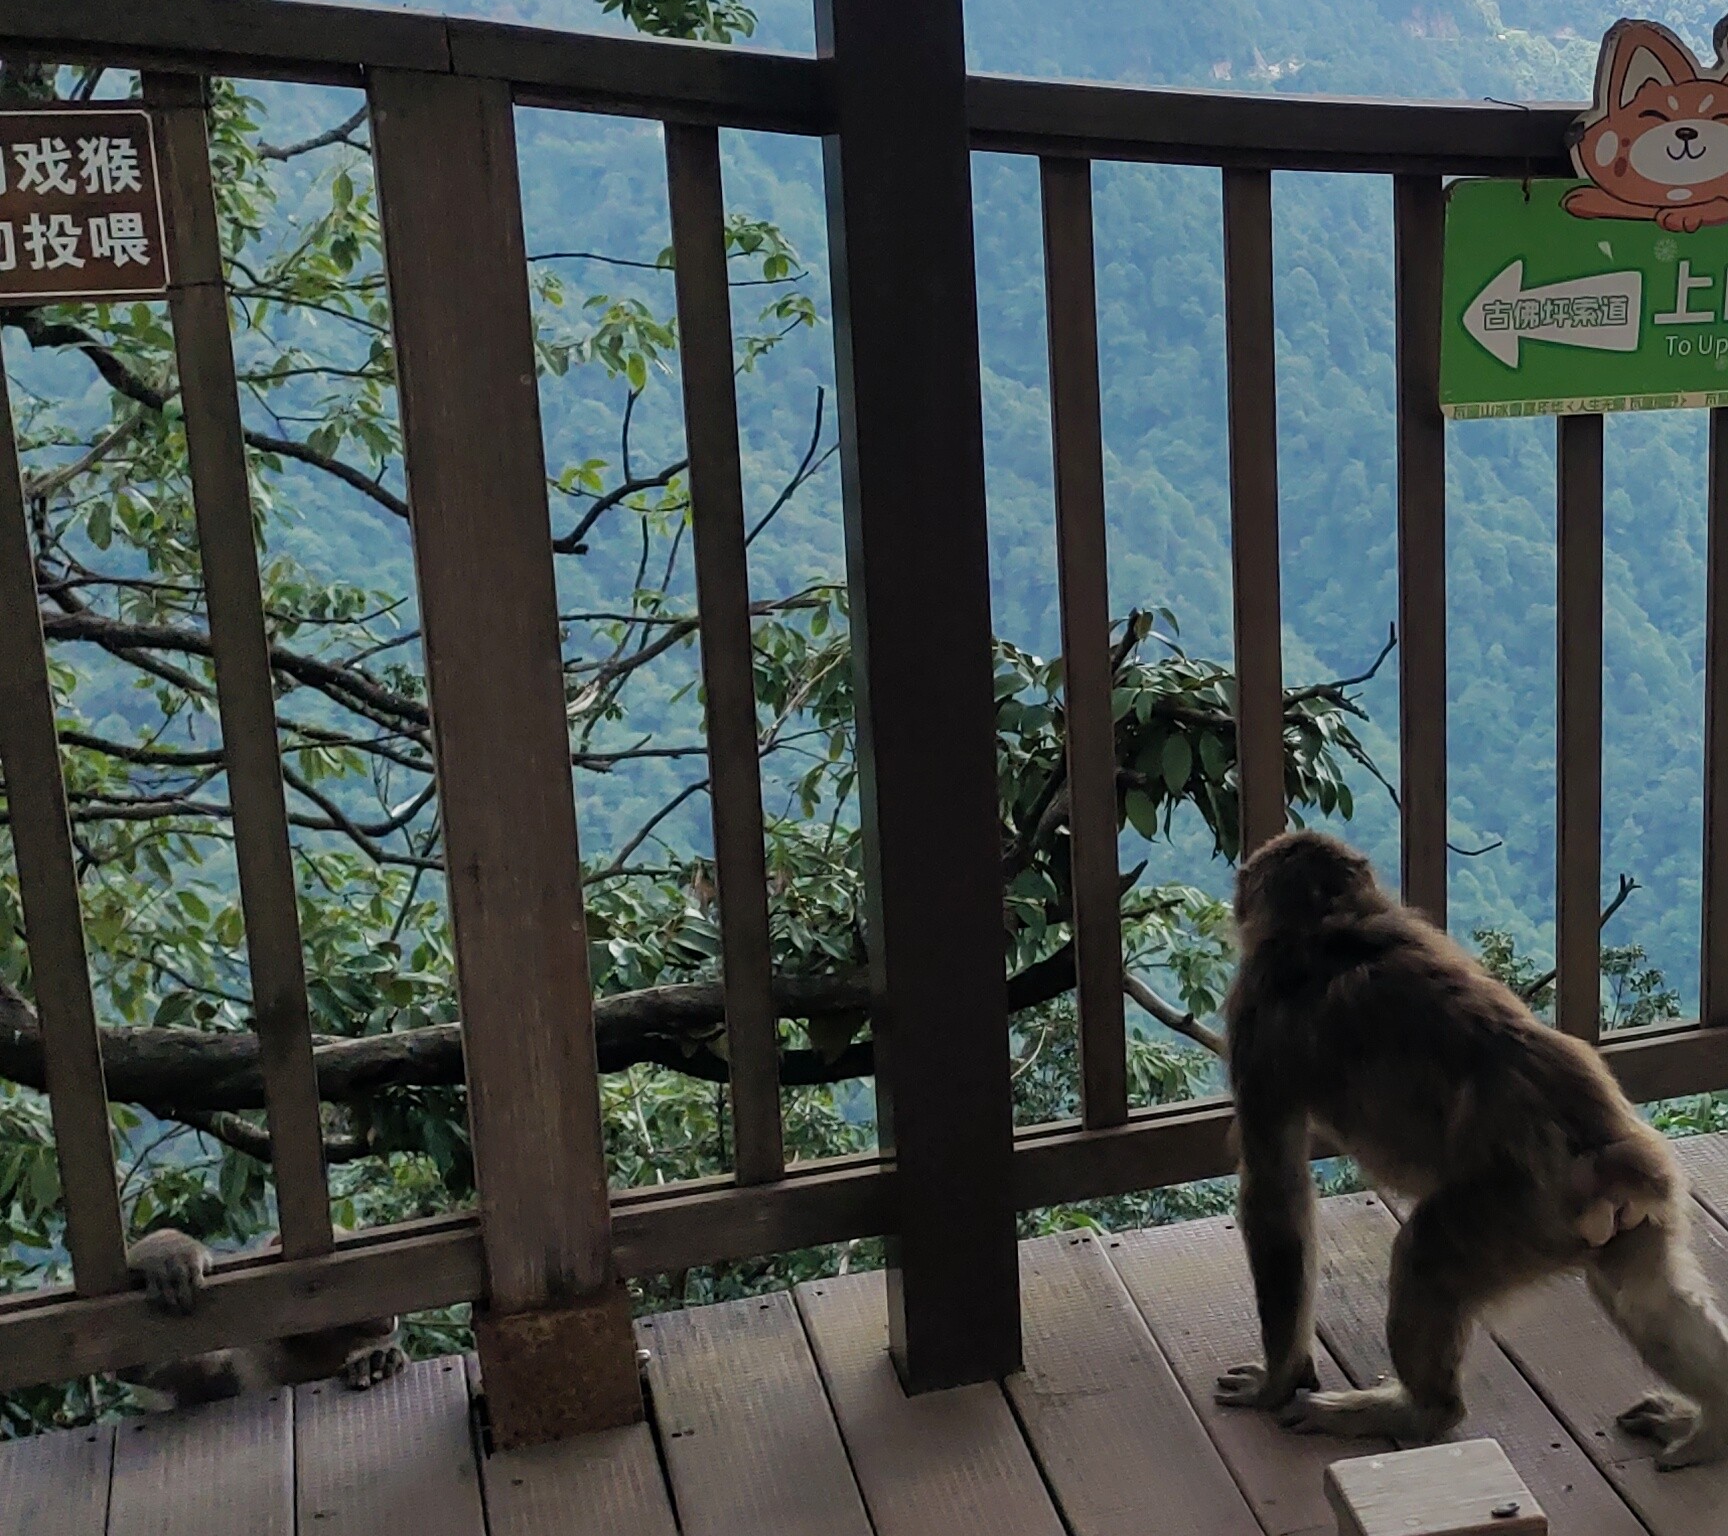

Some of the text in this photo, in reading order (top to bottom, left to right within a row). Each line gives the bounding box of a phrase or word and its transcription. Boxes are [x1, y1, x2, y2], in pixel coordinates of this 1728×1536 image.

[0, 136, 142, 195] 戏猴
[0, 212, 150, 271] 投喂
[1482, 295, 1629, 331] 古佛坪索道
[1665, 335, 1692, 357] To
